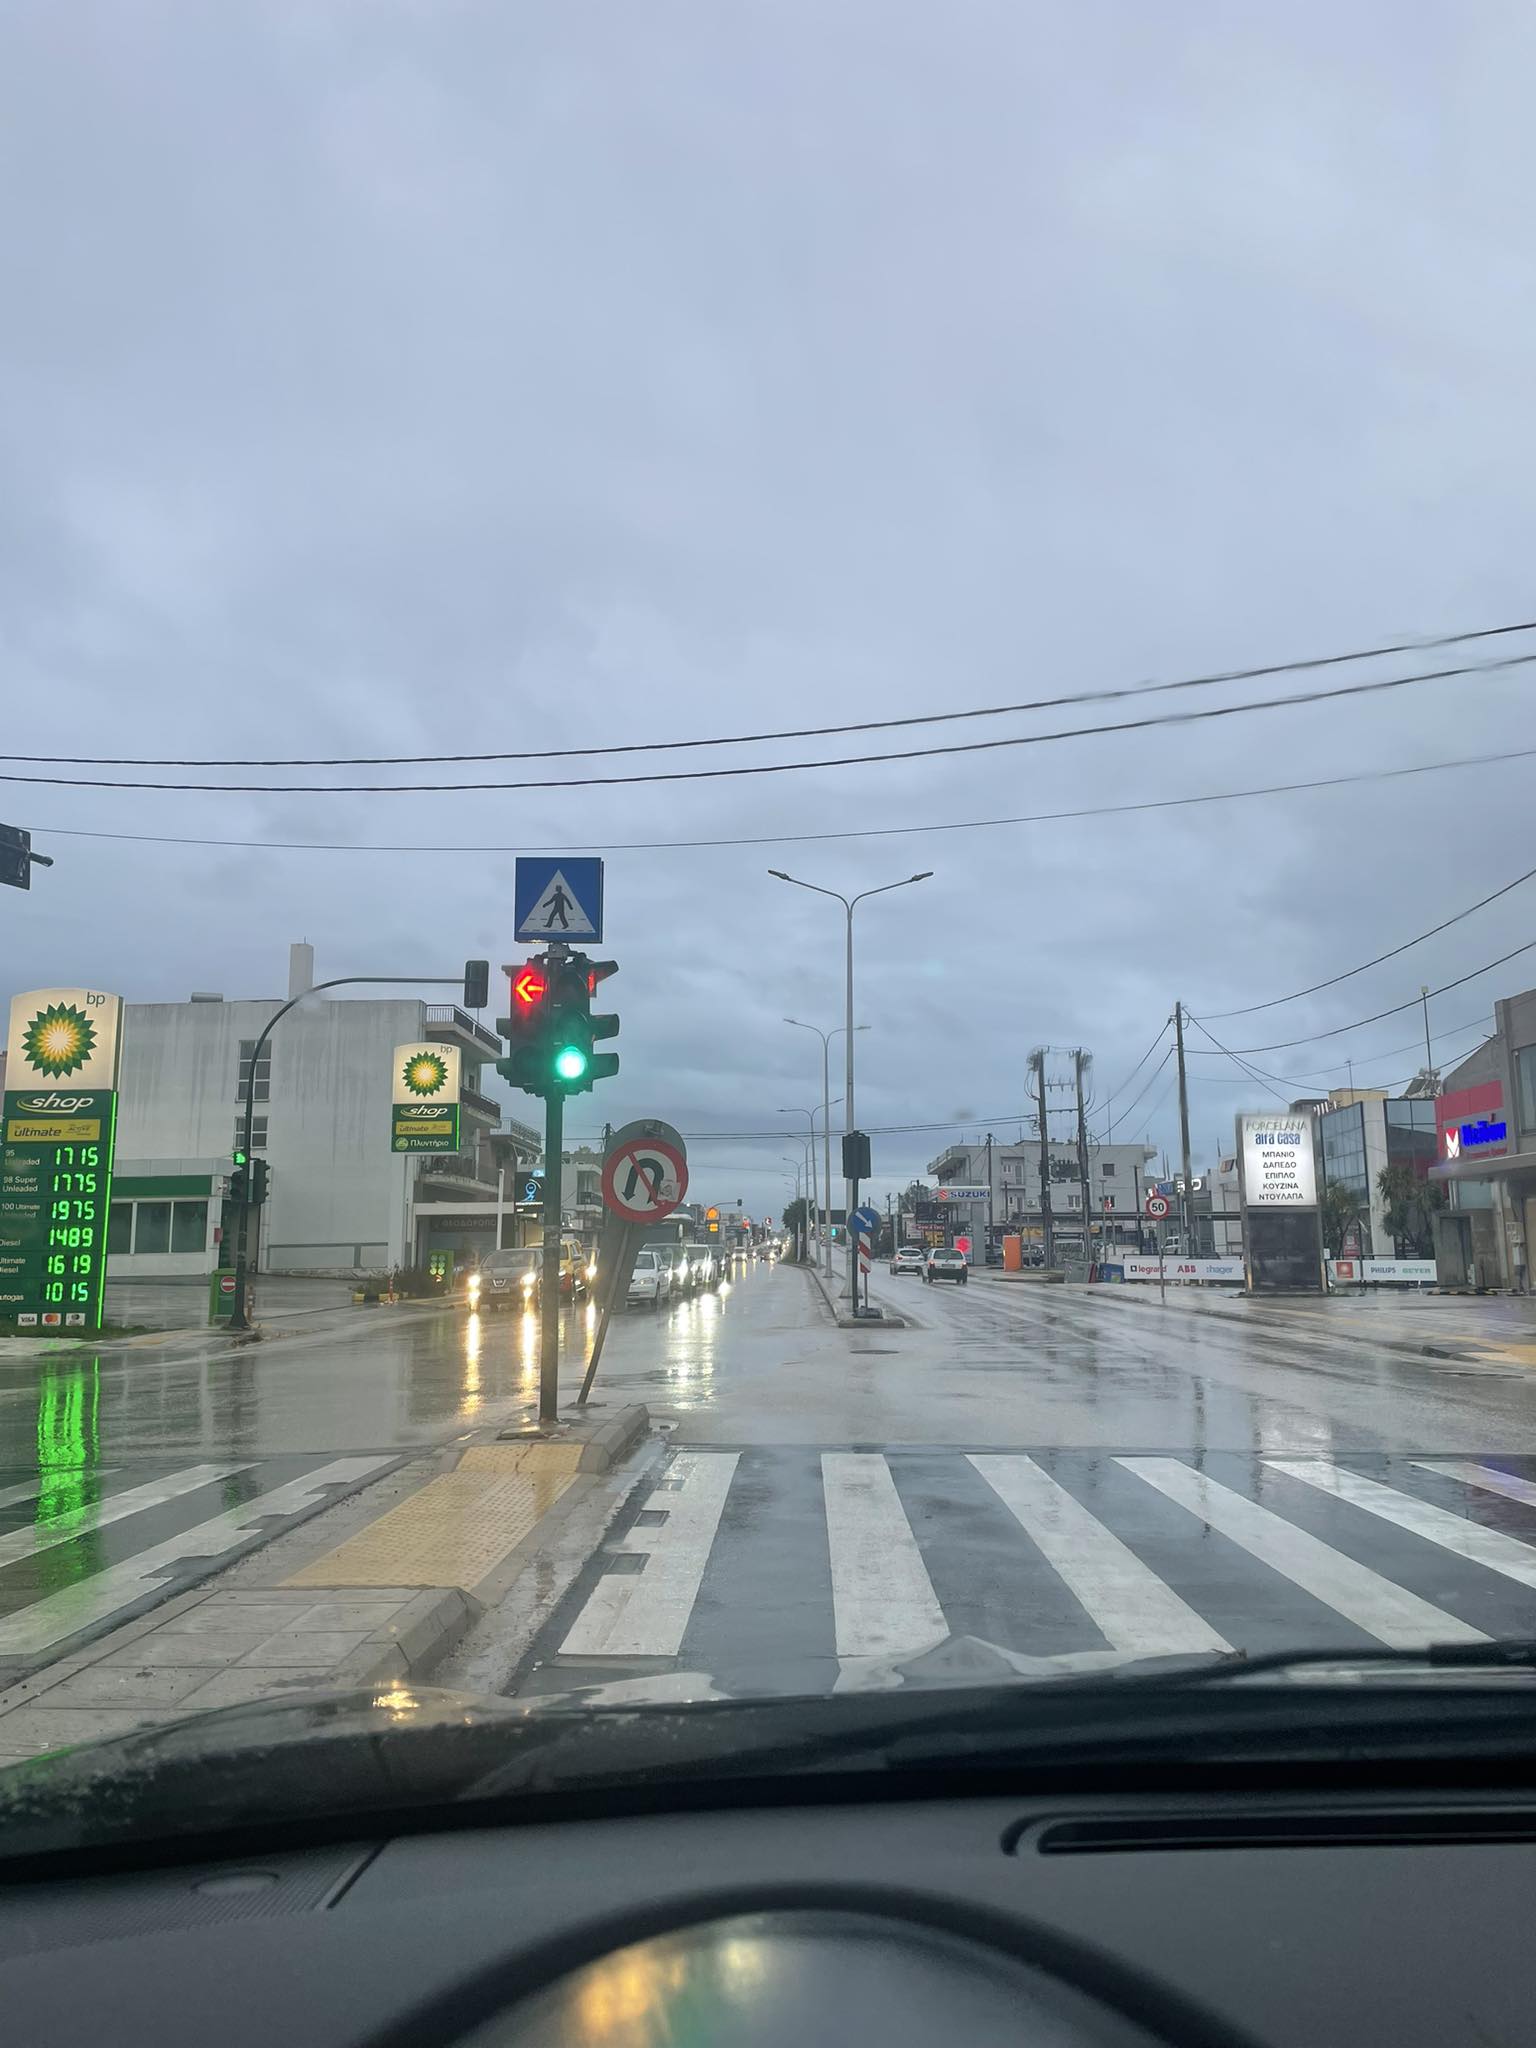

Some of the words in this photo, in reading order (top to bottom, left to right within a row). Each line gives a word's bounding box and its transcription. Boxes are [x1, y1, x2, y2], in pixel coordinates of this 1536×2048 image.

[87, 992, 105, 1008] bp
[30, 1092, 94, 1114] shop
[409, 1105, 448, 1118] shop
[14, 1126, 62, 1137] ultimate
[55, 1146, 98, 1166] 1715
[1263, 1161, 1297, 1169] ΔΑΠΕΔΟ
[2, 1184, 39, 1192] Unleaded
[54, 1173, 97, 1193] 1775
[1263, 1182, 1299, 1190] ΚΟΥΖΙΝΑ
[52, 1200, 96, 1220] 1975
[1151, 1202, 1165, 1212] 50
[49, 1227, 94, 1248] 1489
[48, 1254, 91, 1275] 1619
[1177, 1264, 1197, 1273] ABB
[1370, 1266, 1397, 1274] PHILIPS
[45, 1281, 89, 1302] 1015
